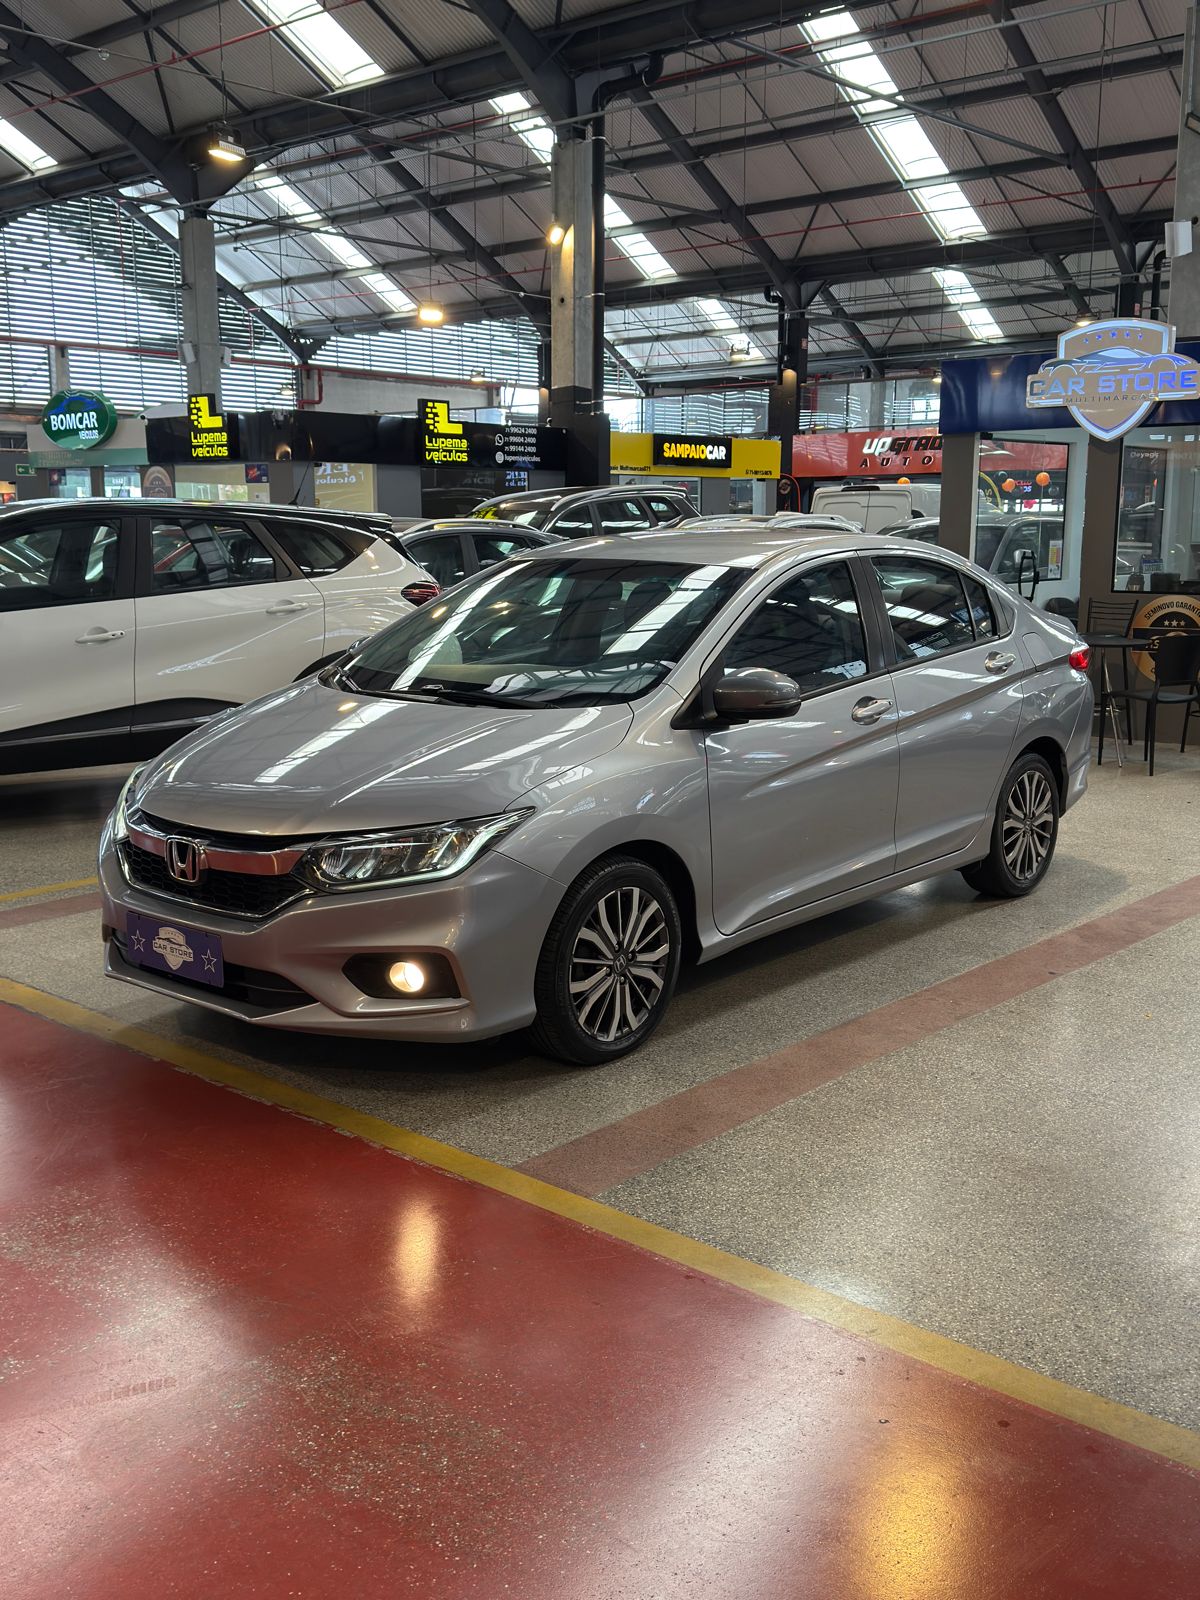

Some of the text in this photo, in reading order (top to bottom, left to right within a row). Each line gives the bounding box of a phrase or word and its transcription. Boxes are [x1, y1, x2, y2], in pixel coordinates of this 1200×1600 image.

[1030, 370, 1197, 396] CAR STORE
[1066, 393, 1156, 403] MULTIMARCAS
[50, 411, 98, 431] BOMCAR
[191, 431, 228, 443] Lupema
[425, 435, 468, 449] Lupema
[191, 444, 228, 457] veículos
[425, 449, 468, 462] veículos
[663, 442, 727, 460] SAMPAIOCAR
[1144, 601, 1174, 620] SEMINOVO
[153, 941, 167, 951] CAR
[169, 946, 192, 959] STORE
